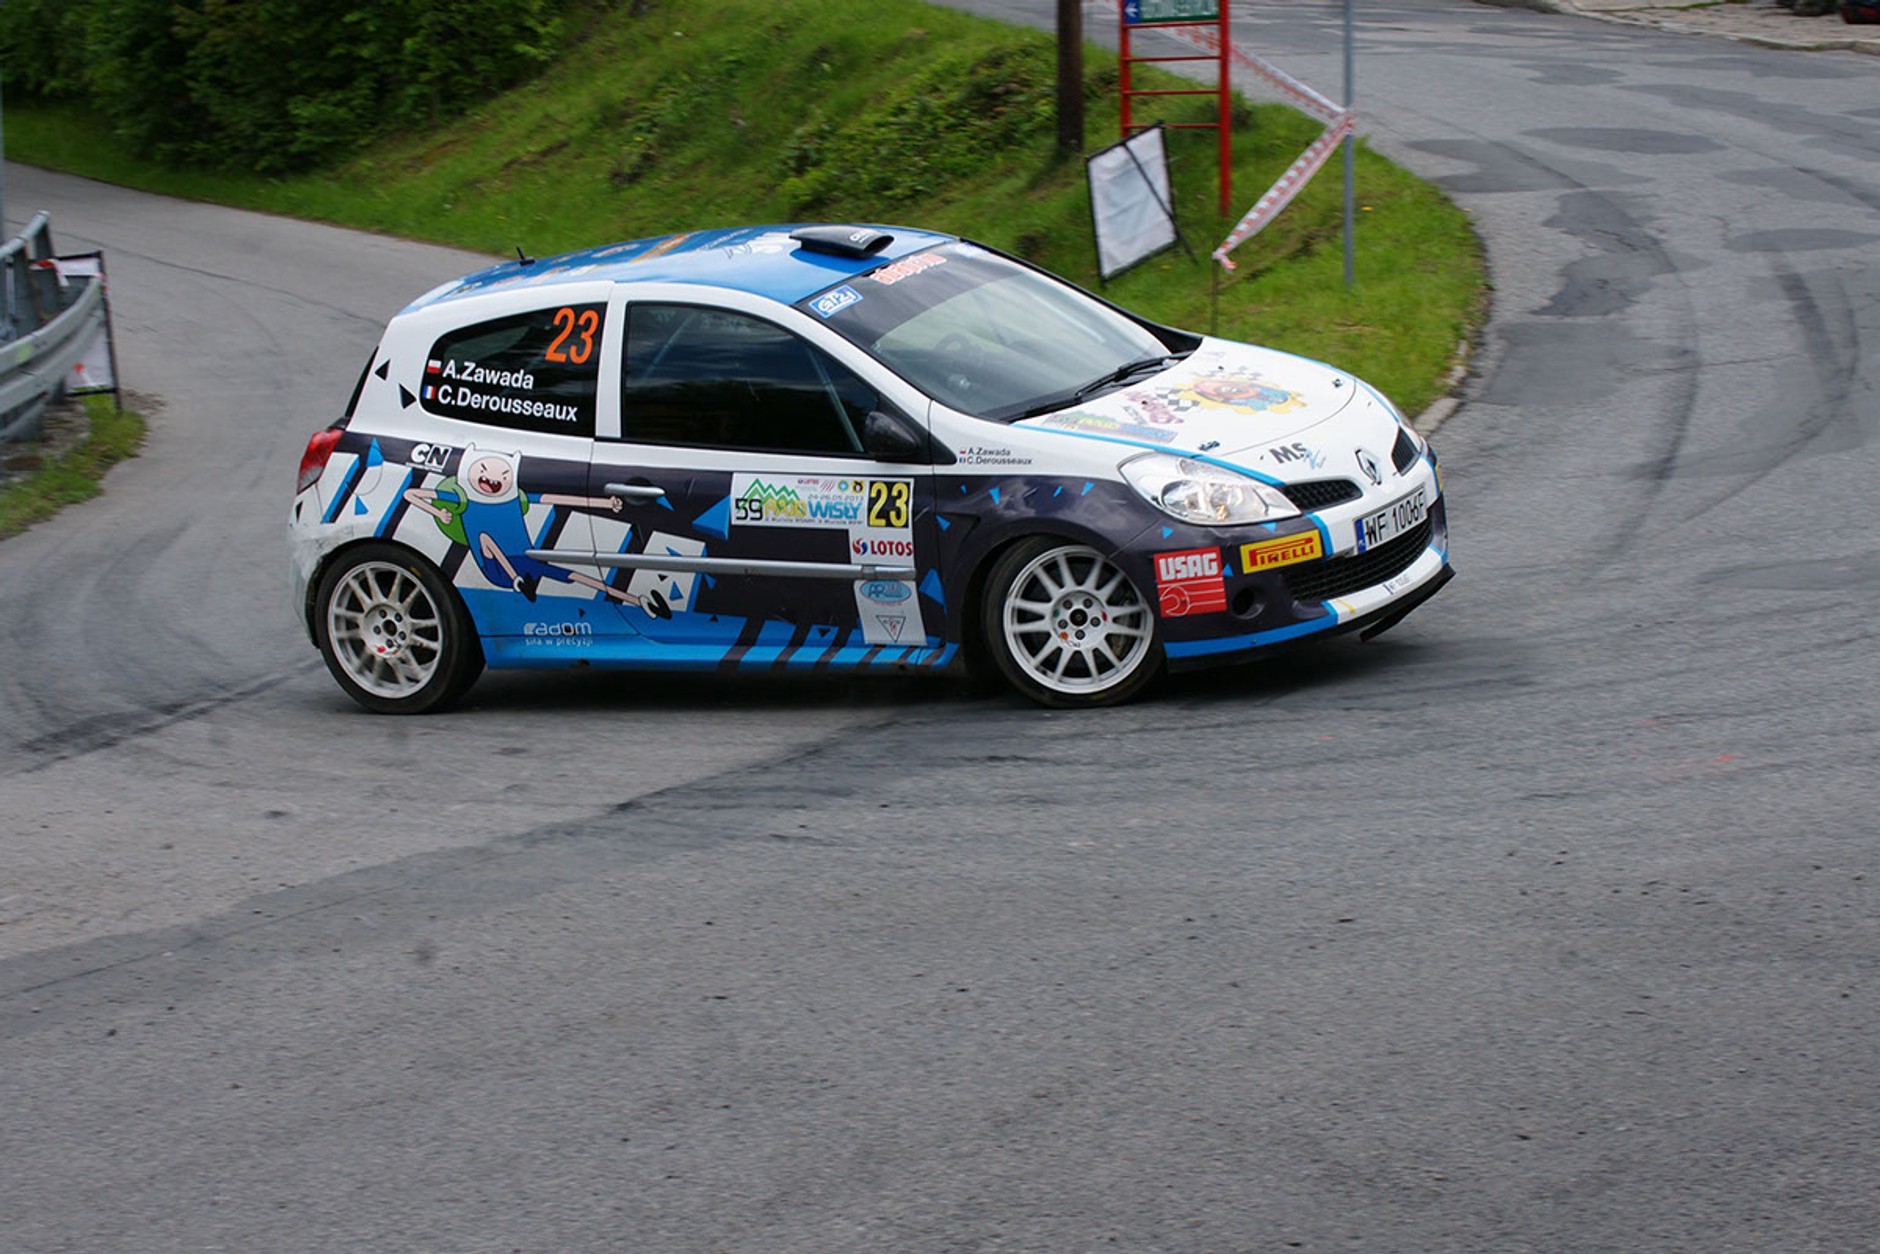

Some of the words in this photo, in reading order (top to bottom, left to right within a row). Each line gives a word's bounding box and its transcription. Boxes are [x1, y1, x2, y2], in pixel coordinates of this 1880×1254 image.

[545, 307, 599, 364] 23
[442, 359, 534, 390] A.Zawada
[437, 384, 578, 422] C.Derousseaux
[411, 443, 452, 469] CN
[735, 498, 763, 521] 59
[869, 481, 909, 527] 23
[1366, 512, 1386, 546] WF
[1393, 490, 1424, 532] 1006F
[870, 540, 912, 557] LOTOS
[1250, 537, 1314, 567] PIRELLI
[1159, 552, 1219, 581] USAG
